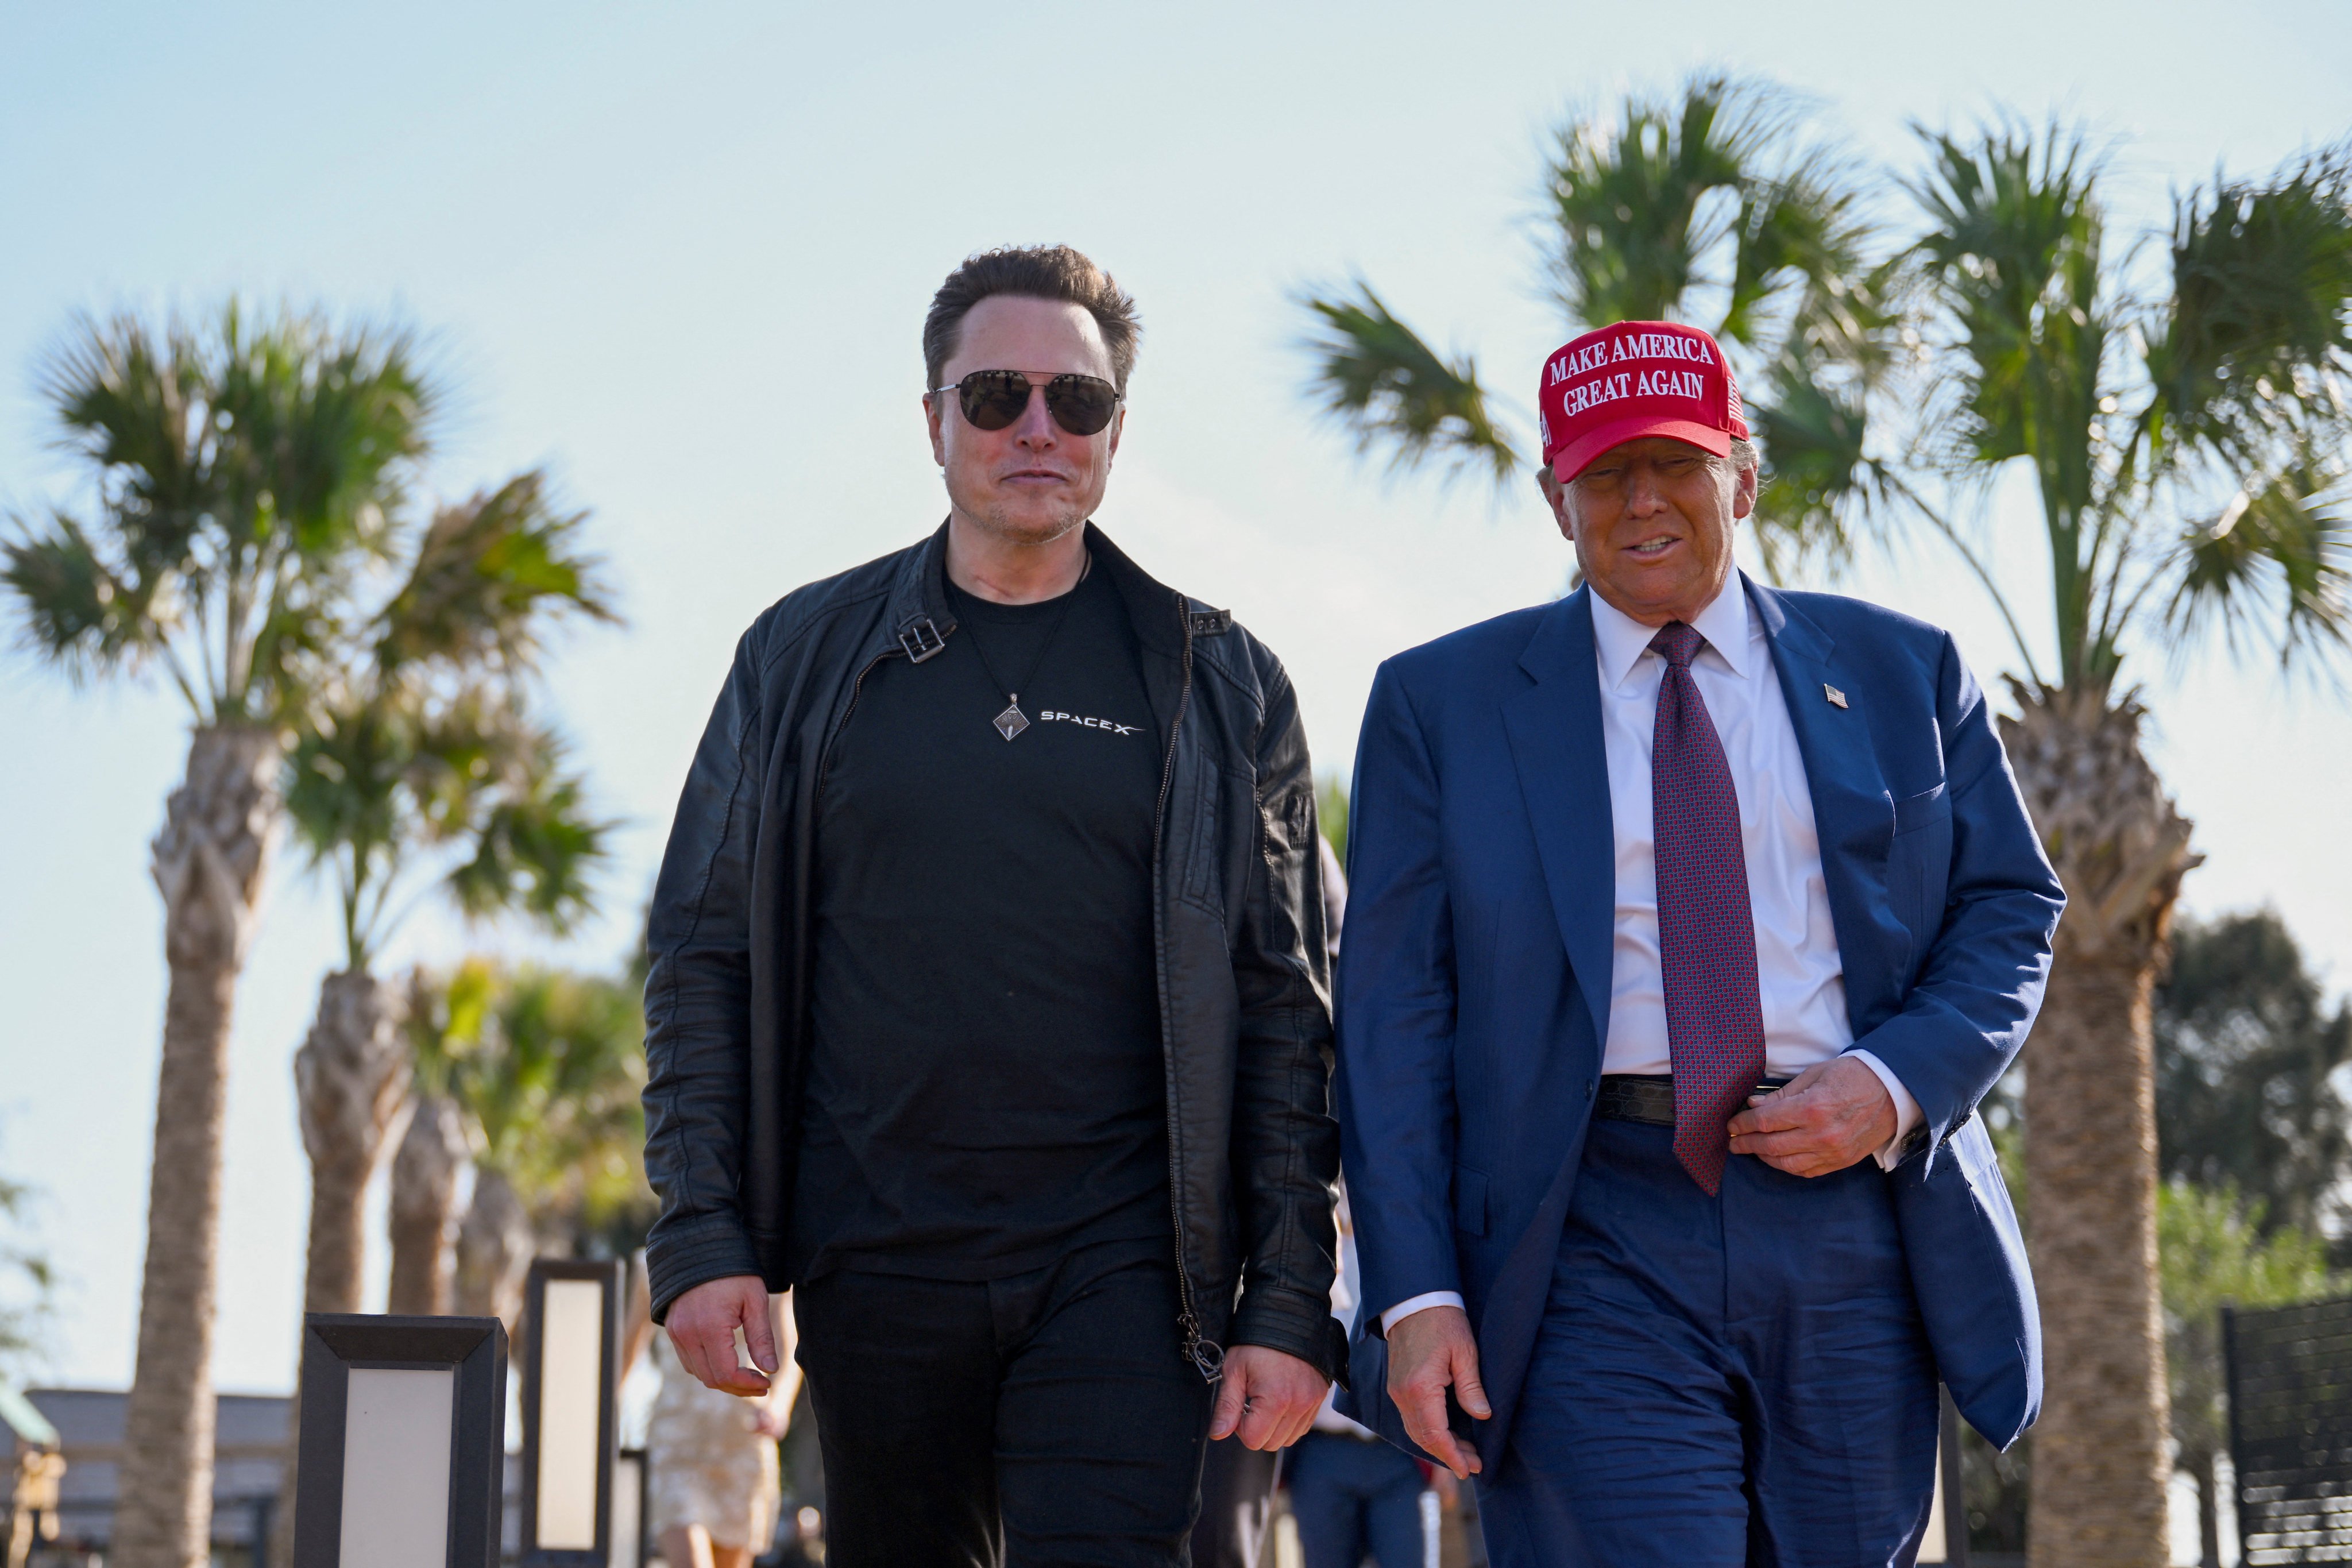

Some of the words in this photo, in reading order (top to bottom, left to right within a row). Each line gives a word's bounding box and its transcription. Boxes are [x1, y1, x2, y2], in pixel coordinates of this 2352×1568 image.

[1550, 341, 1608, 387] MAKE
[1611, 334, 1714, 365] AMERICA
[1563, 373, 1631, 417] GREAT
[1636, 370, 1704, 401] AGAIN
[1041, 711, 1145, 735] SPACEX
